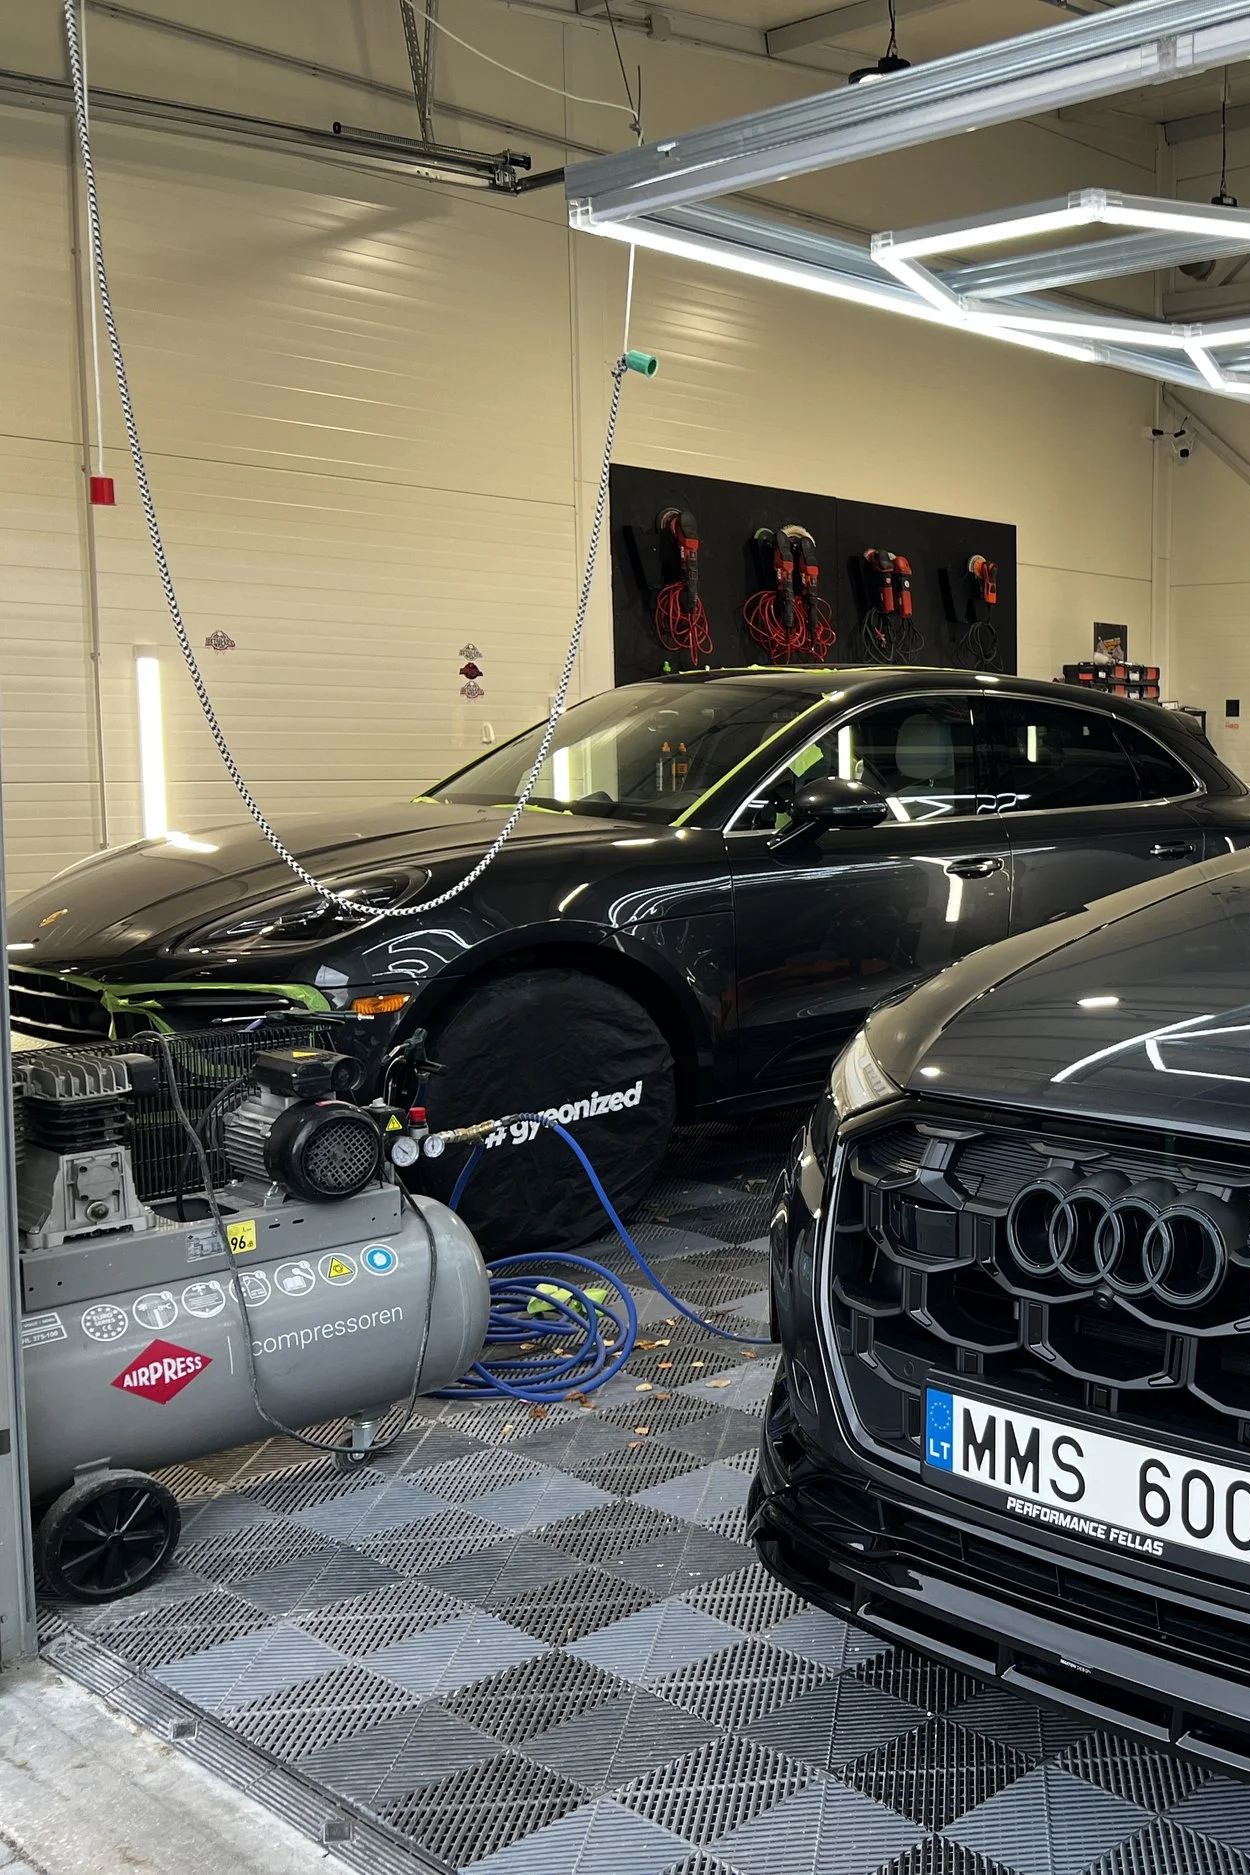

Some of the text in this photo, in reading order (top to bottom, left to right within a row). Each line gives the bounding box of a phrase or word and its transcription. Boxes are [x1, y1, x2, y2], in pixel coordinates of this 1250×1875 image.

[231, 1235, 246, 1252] 96
[93, 1312, 113, 1322] EURO
[94, 1317, 116, 1327] SERIES
[123, 1305, 404, 1388] AIRPRESS compressoren
[929, 1437, 951, 1461] LT
[962, 1407, 1086, 1503] MMS
[1006, 1495, 1164, 1557] PERFORMANCE FELLAS
